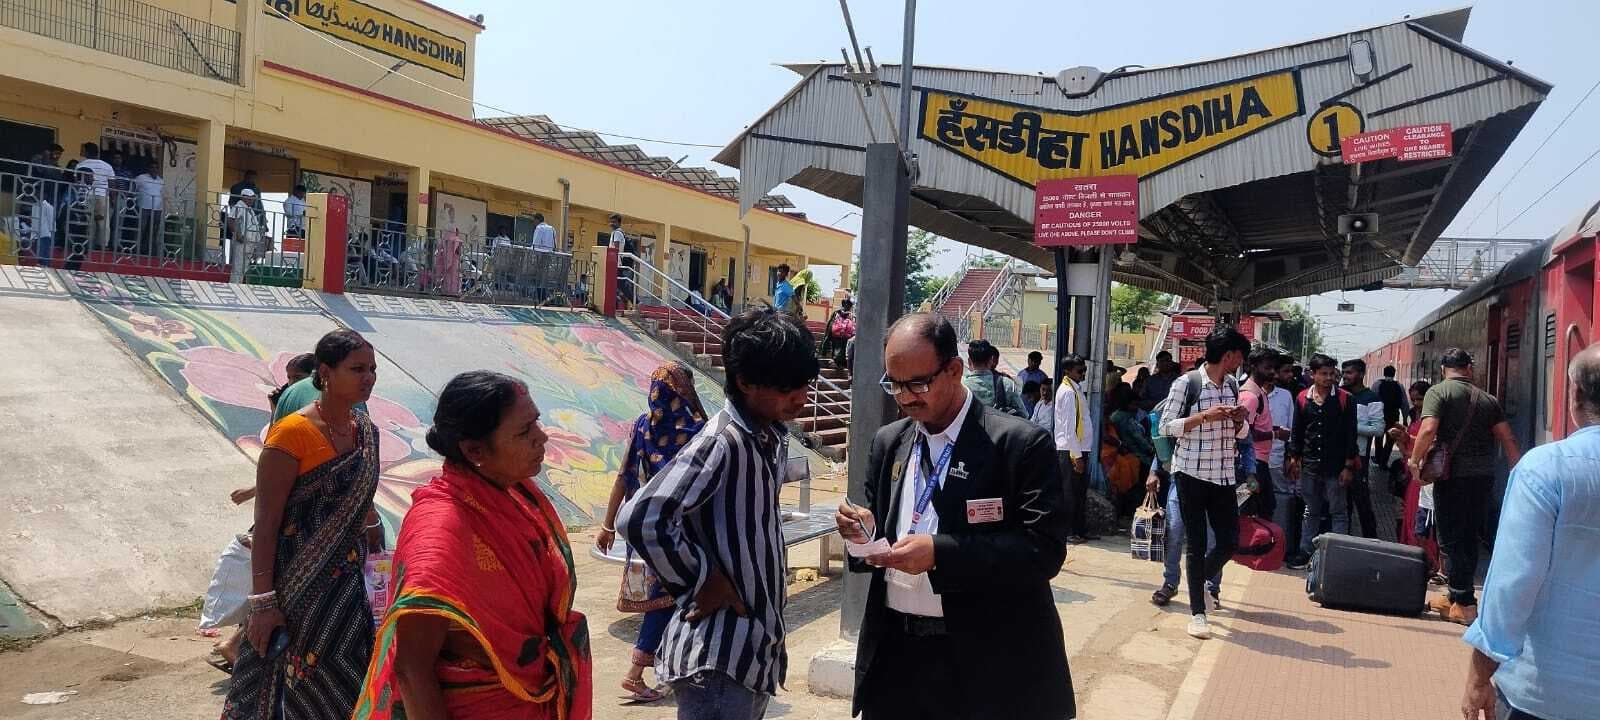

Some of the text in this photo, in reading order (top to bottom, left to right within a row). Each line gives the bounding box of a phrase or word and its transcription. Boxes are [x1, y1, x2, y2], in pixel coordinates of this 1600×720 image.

[382, 23, 464, 68] HANSDIHA
[1100, 85, 1272, 169] HANSDIHA
[1322, 111, 1341, 151] 1
[1406, 125, 1442, 135] CAUTION
[937, 98, 1090, 169] हँसडीहा
[1403, 131, 1446, 141] CLEARANCE
[1353, 133, 1390, 145] CAUTION
[1404, 149, 1446, 159] RESTRICTED
[1073, 183, 1097, 191] खतरा
[1069, 211, 1102, 219] DANGER
[1080, 229, 1101, 237] PLEASE
[1190, 326, 1208, 335] FOOD
